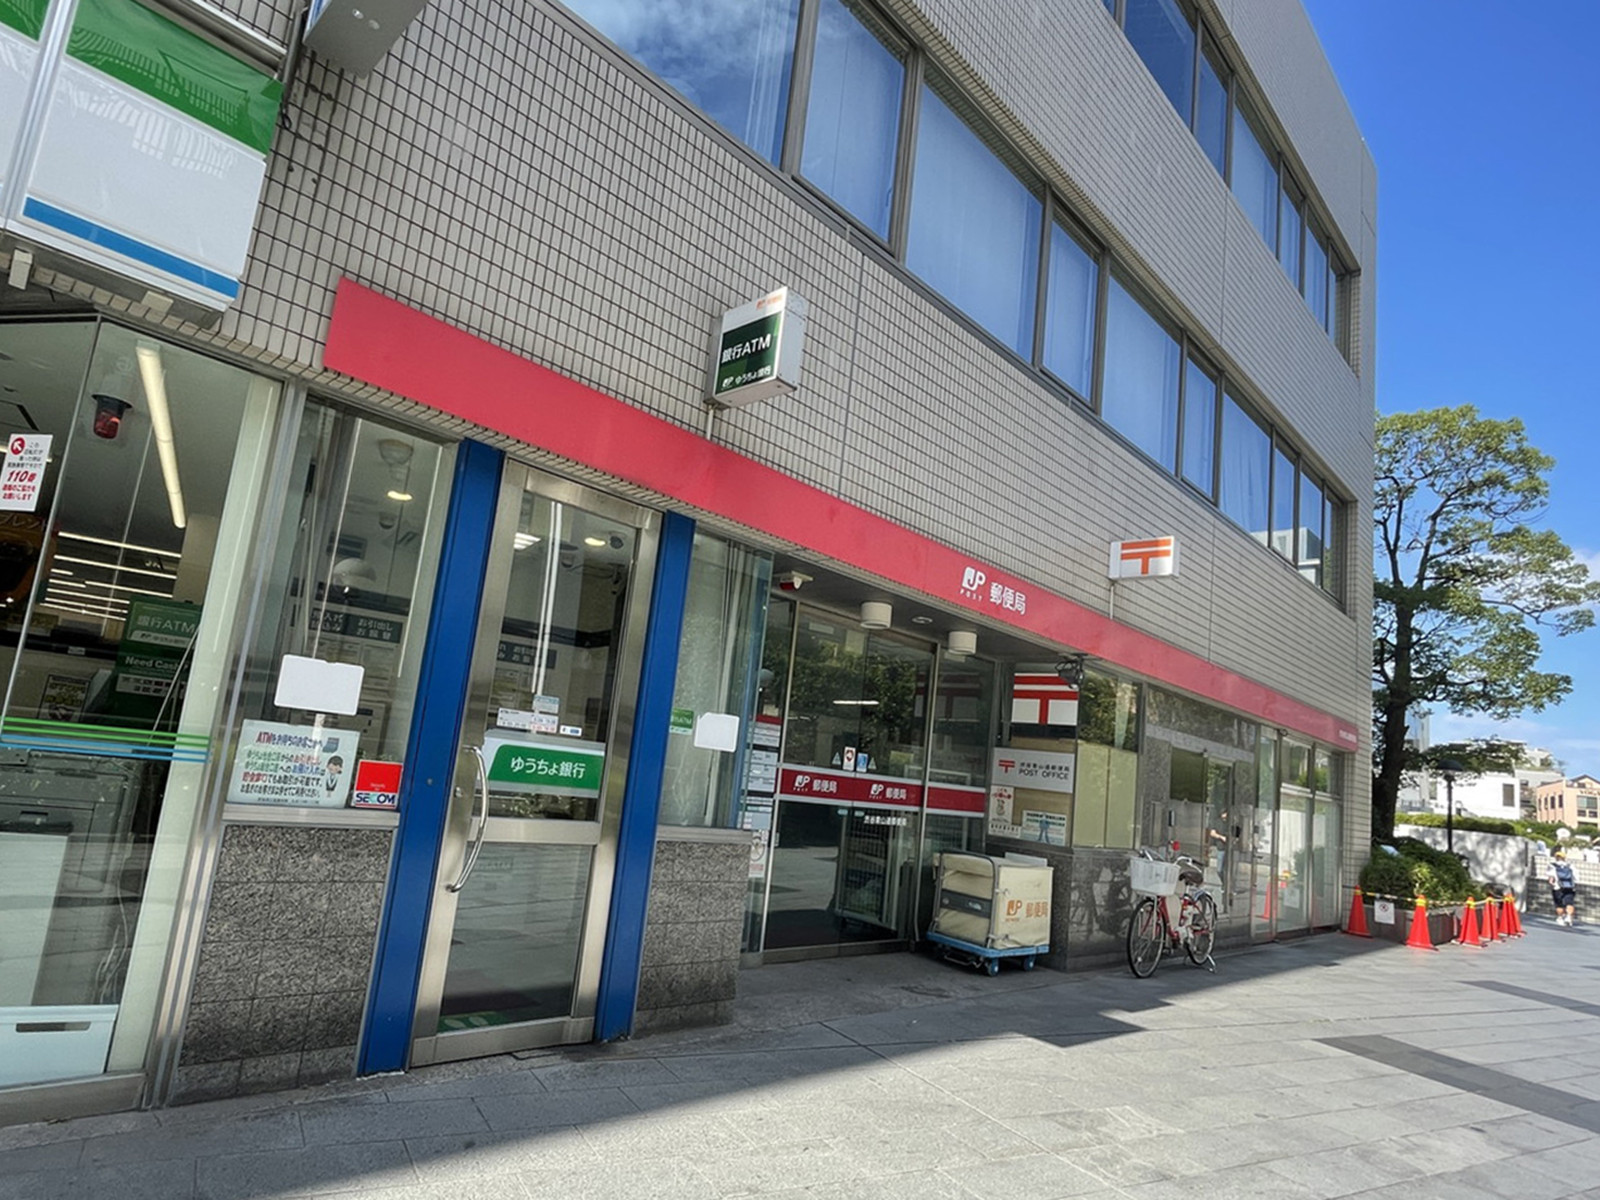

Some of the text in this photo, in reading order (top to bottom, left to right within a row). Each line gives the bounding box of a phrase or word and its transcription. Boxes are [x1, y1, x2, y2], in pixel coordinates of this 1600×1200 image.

[721, 333, 771, 364] 銀行ATM
[989, 581, 1026, 616] 郵便局
[510, 756, 586, 779] ゆうちょ銀行
[1019, 768, 1069, 780] POST OFFICE
[356, 792, 396, 805] SECOM
